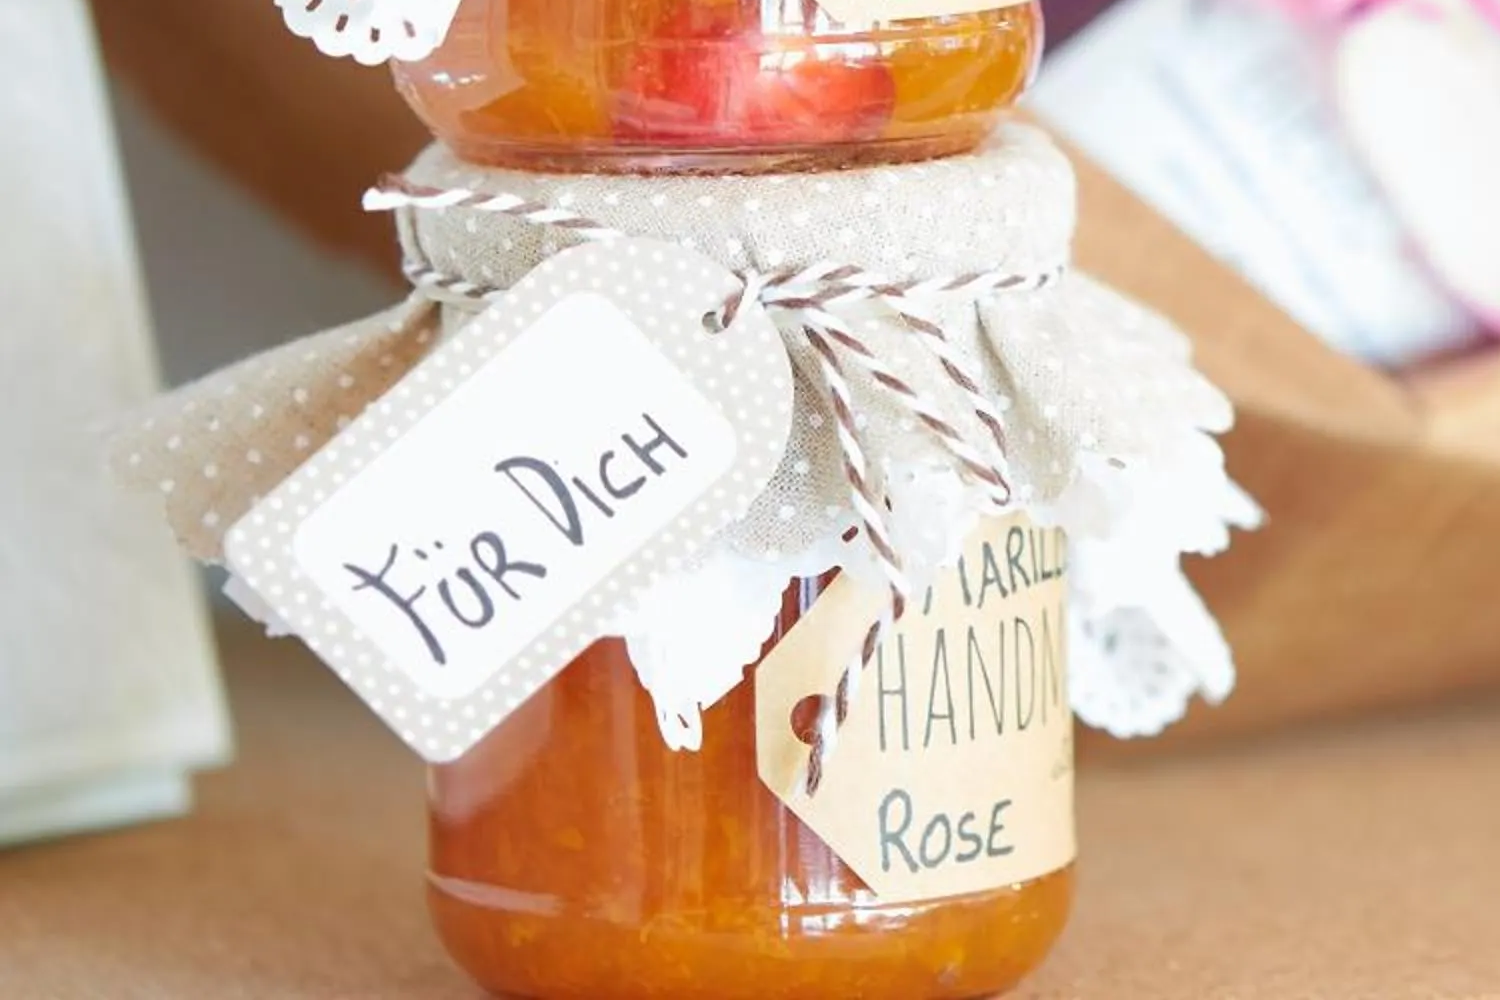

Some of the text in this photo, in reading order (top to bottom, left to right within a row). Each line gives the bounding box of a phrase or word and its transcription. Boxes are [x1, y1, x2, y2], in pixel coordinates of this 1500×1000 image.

[342, 411, 689, 665] FÜR DICH
[878, 788, 1015, 873] ROSE
